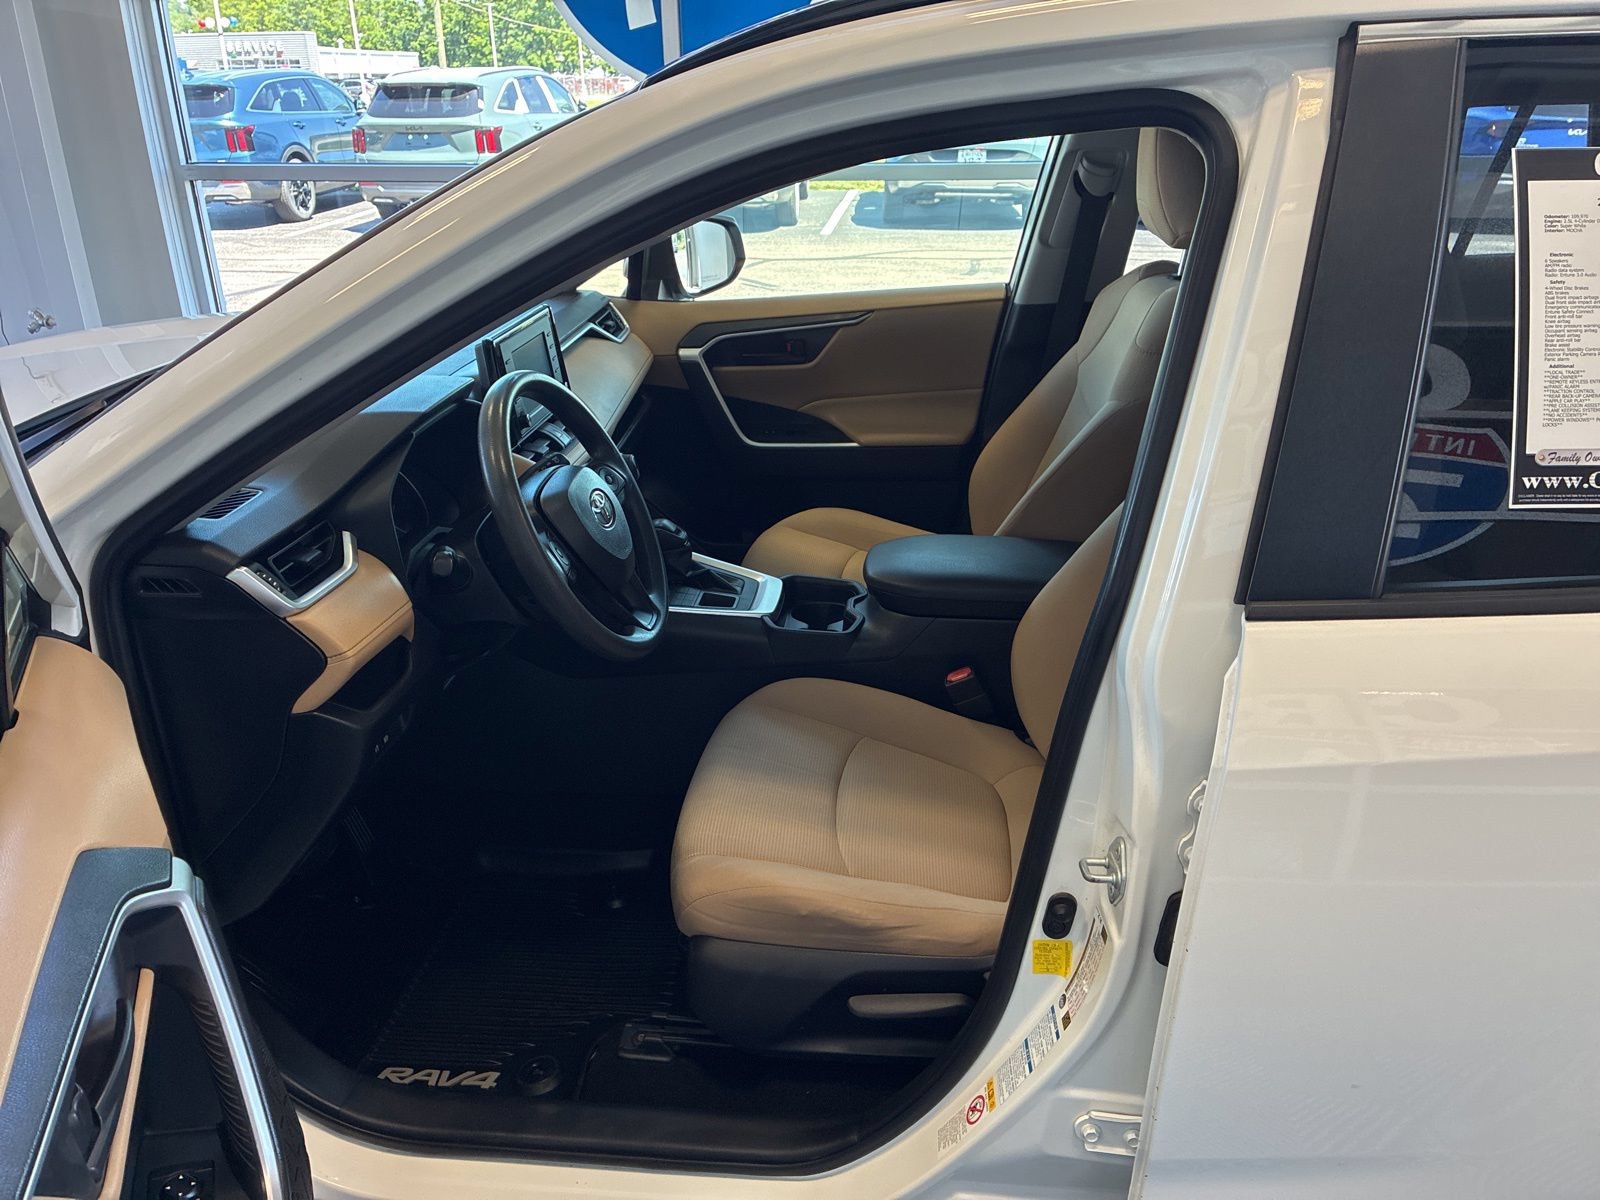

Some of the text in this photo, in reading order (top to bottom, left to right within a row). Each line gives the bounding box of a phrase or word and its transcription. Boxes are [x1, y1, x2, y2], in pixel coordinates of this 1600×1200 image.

[226, 40, 284, 54] SERVICE
[1548, 452, 1581, 464] Family
[377, 1067, 501, 1089] RAV4
